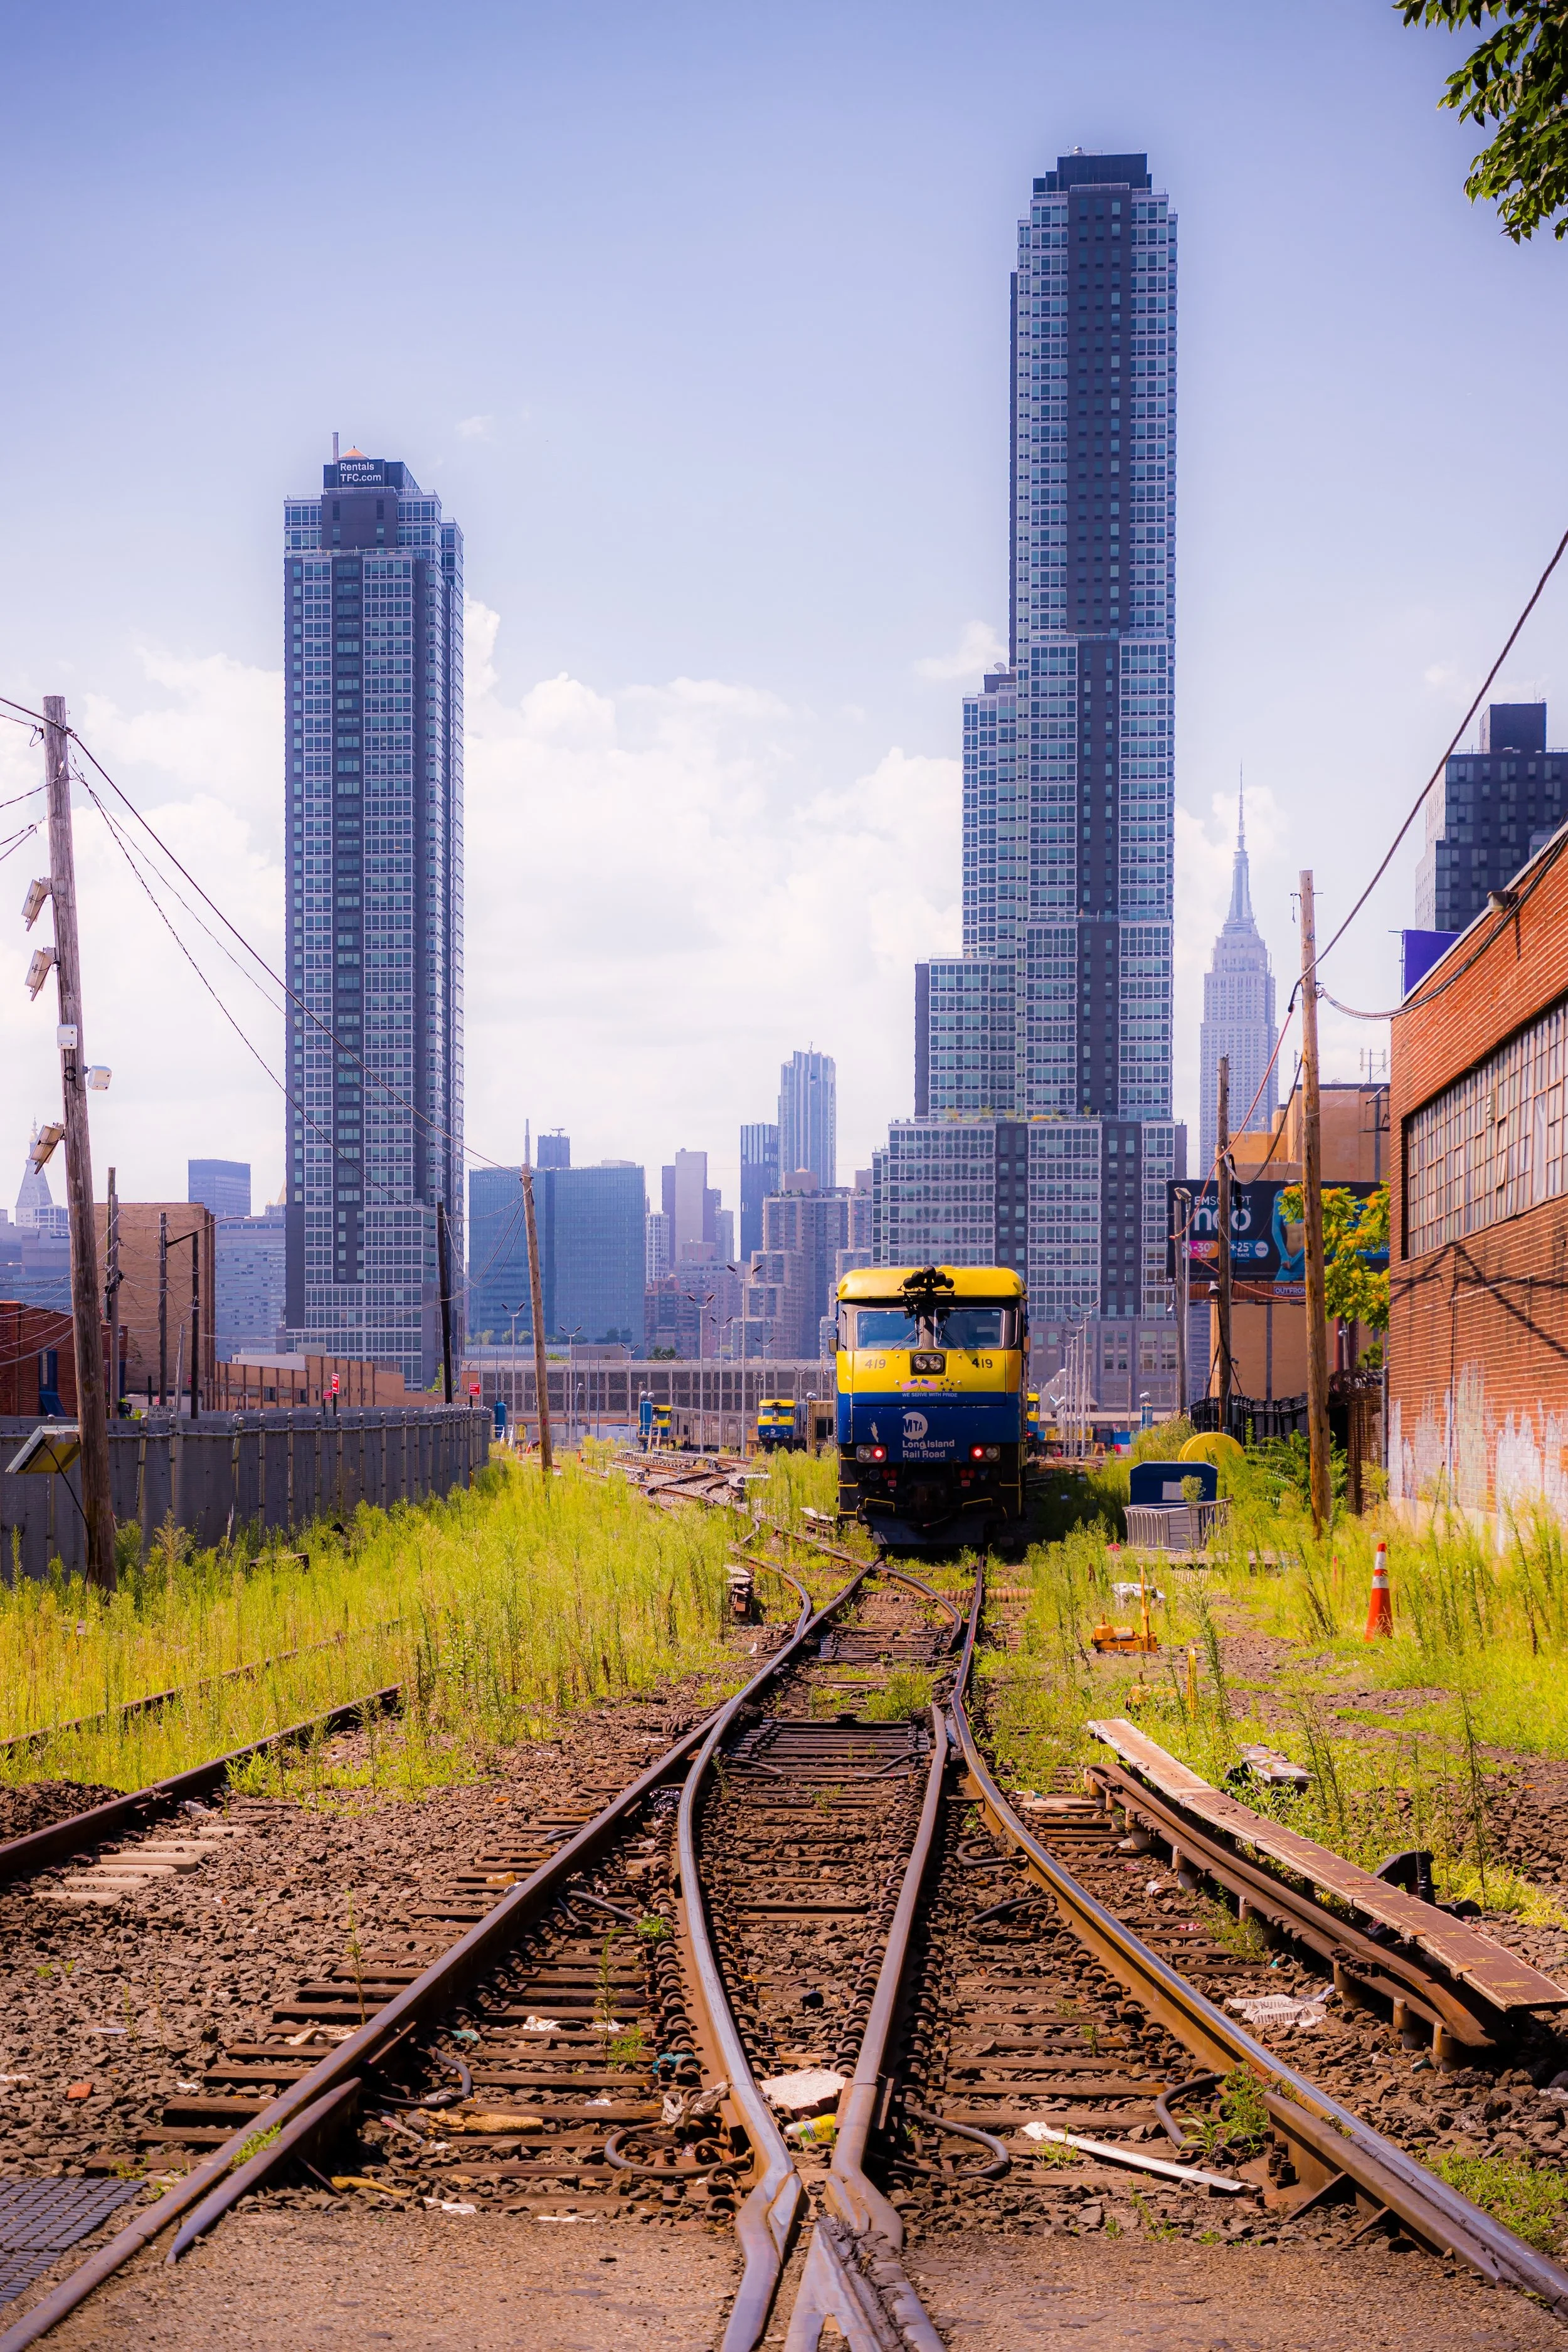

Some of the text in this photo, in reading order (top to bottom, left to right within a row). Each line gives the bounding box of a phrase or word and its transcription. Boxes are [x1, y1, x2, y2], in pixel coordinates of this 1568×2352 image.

[340, 462, 375, 471] Rentals
[340, 474, 381, 482] TFC.com
[1194, 1196, 1252, 1205] EMSLT
[865, 1359, 886, 1369] 419
[972, 1358, 993, 1369] 419
[903, 1417, 923, 1434] MTA
[903, 1439, 955, 1449] Long Island
[903, 1449, 946, 1458] Rail Road
